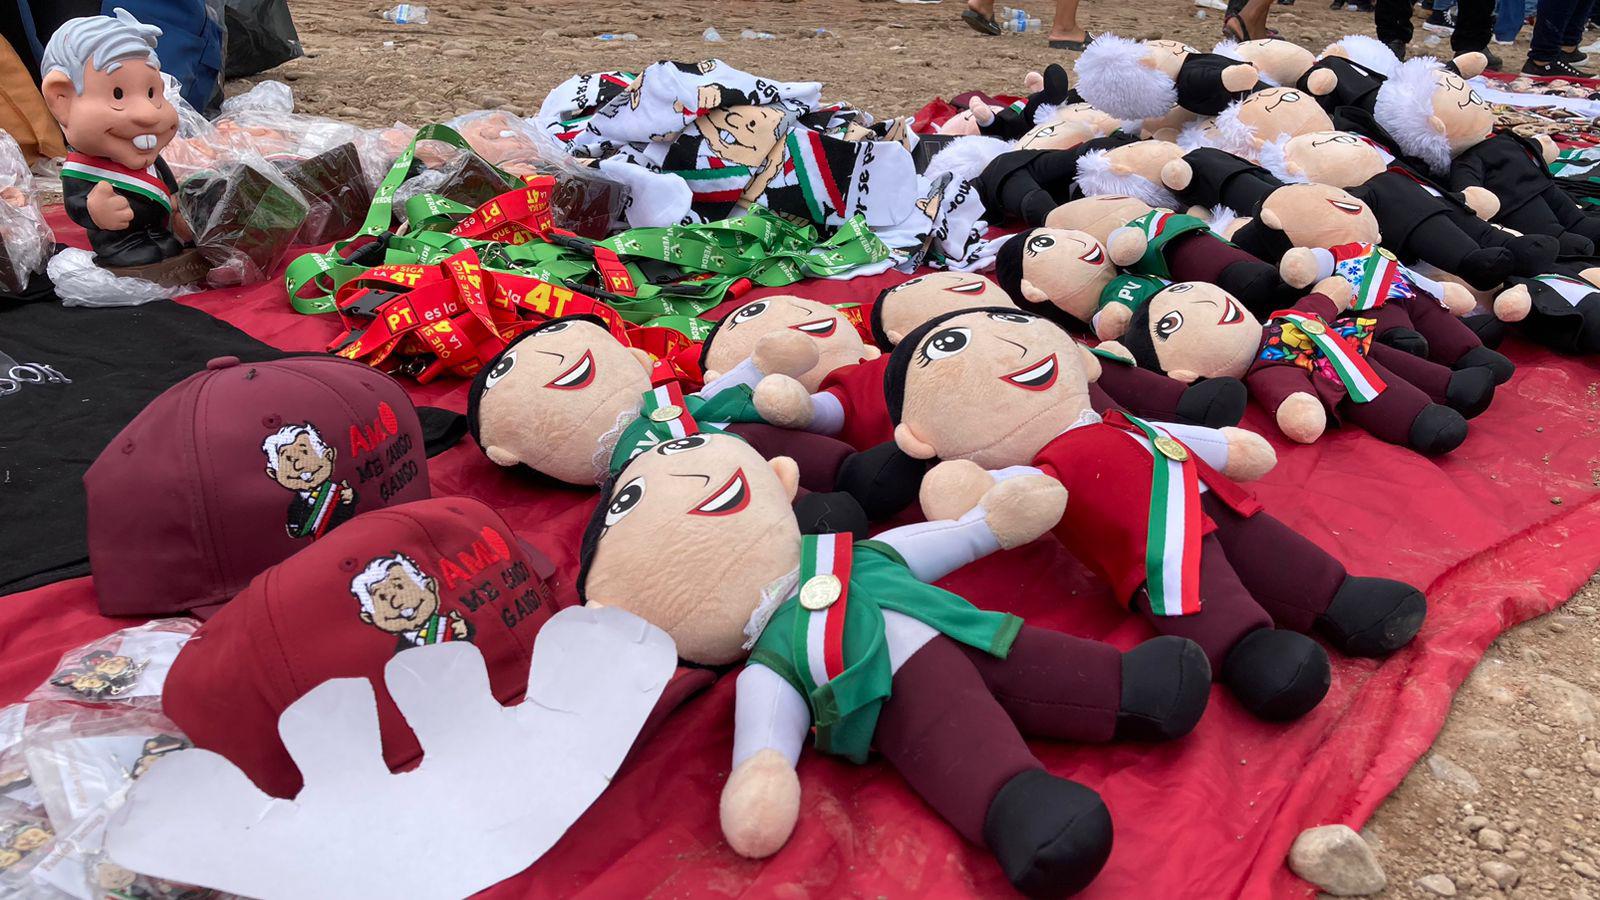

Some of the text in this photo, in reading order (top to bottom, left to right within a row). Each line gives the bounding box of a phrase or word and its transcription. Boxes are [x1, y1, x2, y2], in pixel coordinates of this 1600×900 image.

[858, 169, 870, 195] se
[424, 193, 441, 216] VERDE
[481, 202, 501, 223] PT
[492, 226, 511, 241] QUE
[662, 236, 671, 262] VERDE
[701, 245, 713, 270] VERDE
[390, 271, 421, 286] 4T
[400, 266, 425, 274] SIGA
[462, 260, 481, 290] 4T
[778, 260, 797, 283] VERDE
[461, 283, 475, 305] QUE
[613, 277, 630, 290] PT
[1117, 281, 1142, 302] PV
[474, 292, 483, 305] LA
[508, 289, 522, 305] la
[524, 282, 574, 318] 4T
[387, 306, 414, 332] PT
[424, 302, 458, 321] es la
[688, 317, 701, 341] VERDE
[431, 336, 452, 359] QUE
[449, 333, 463, 350] LA
[459, 580, 500, 613] ME
